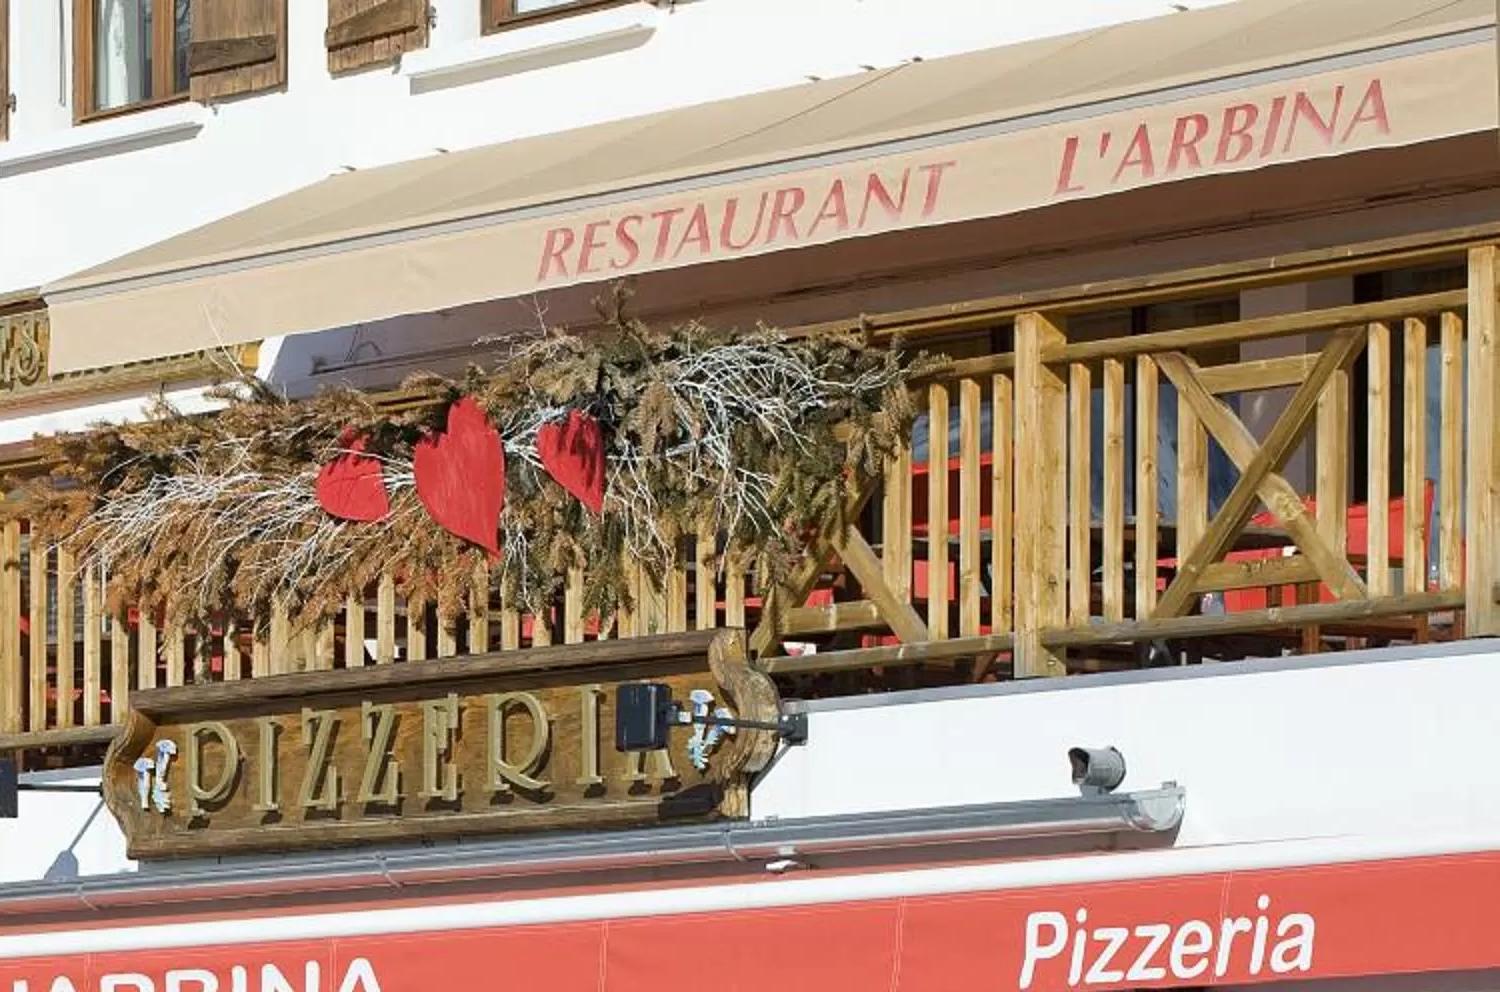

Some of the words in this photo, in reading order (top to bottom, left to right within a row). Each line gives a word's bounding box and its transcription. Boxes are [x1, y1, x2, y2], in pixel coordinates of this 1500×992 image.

[536, 160, 956, 282] RESTAURANT
[1054, 77, 1392, 197] L'ARBINA
[1019, 894, 1316, 990] Pizzeria
